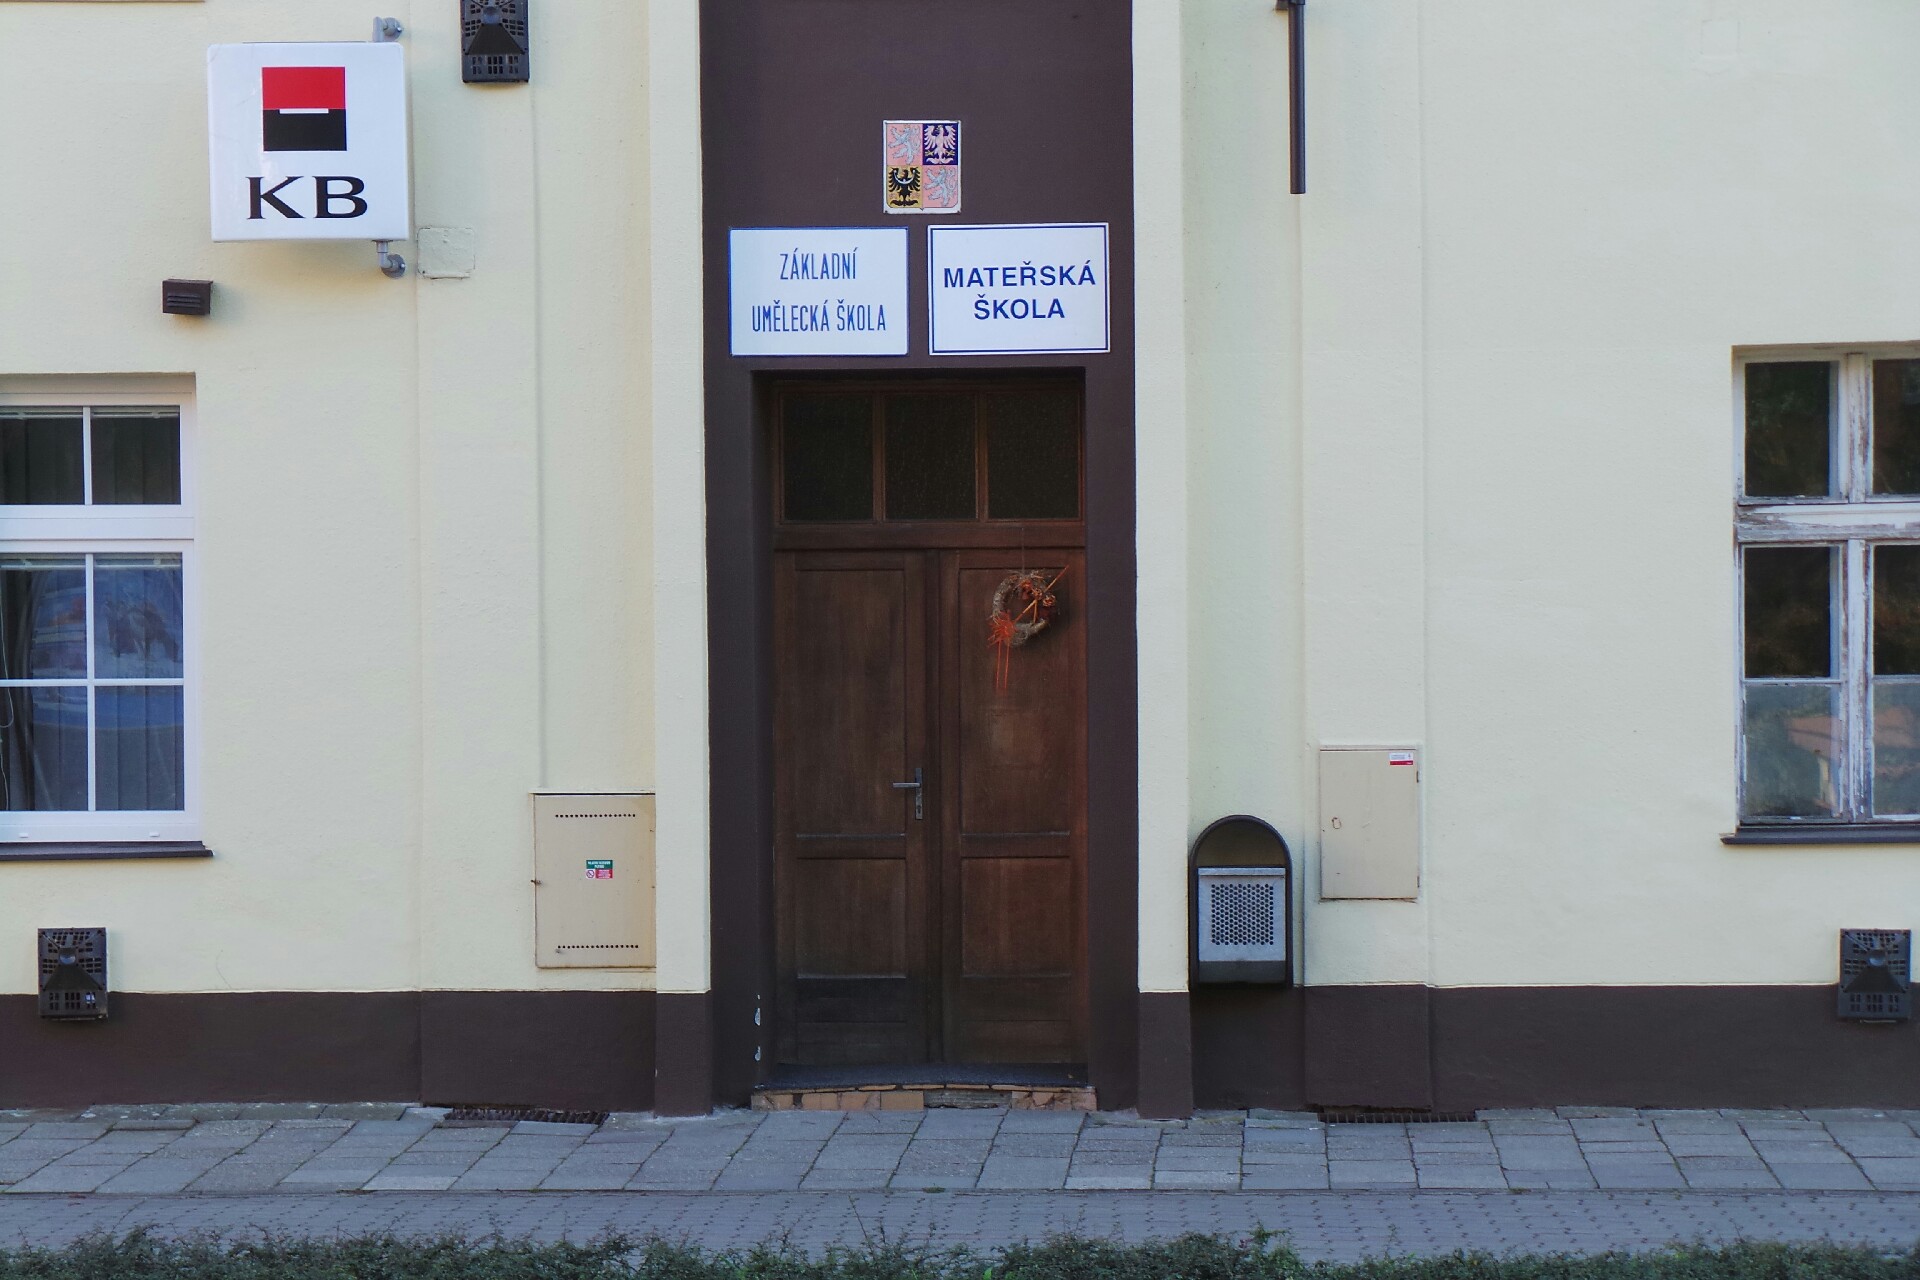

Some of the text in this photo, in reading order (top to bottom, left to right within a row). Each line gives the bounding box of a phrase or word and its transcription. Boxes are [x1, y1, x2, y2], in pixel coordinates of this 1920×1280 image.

[245, 175, 368, 220] KB
[779, 247, 858, 281] ZÁKLADNÍ
[943, 260, 1096, 288] MATEŘSKÁ
[751, 298, 887, 333] UMĚLECKÁ ŠKOLA
[973, 293, 1065, 320] ŠKOLA
